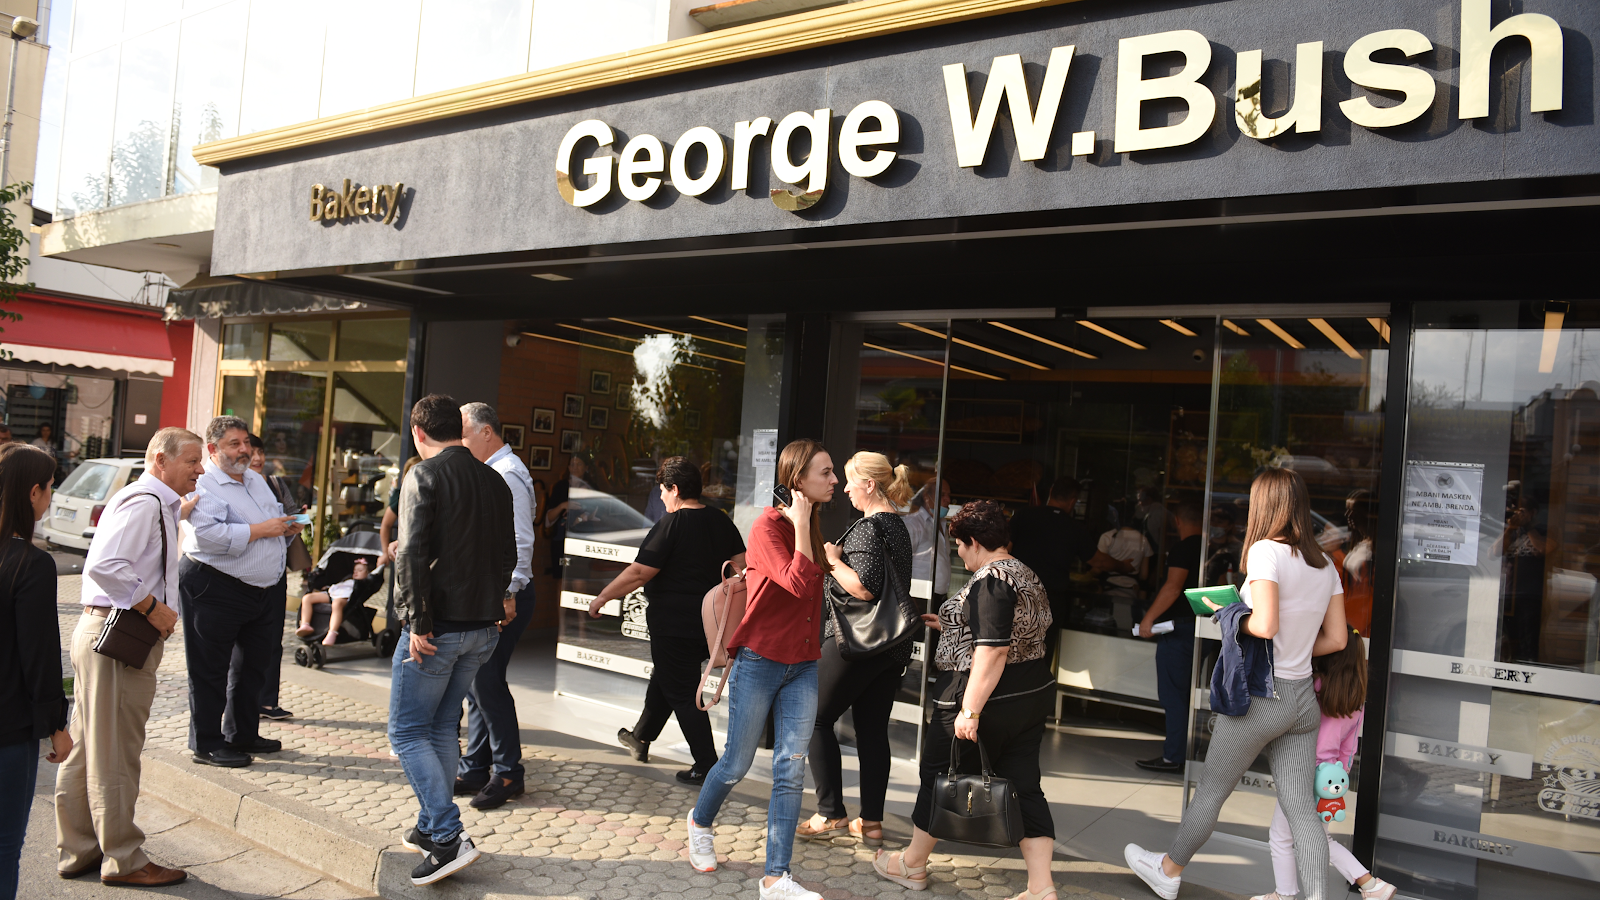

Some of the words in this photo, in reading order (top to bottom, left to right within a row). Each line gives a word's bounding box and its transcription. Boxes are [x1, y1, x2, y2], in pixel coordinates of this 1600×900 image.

[555, 100, 901, 211] George
[309, 178, 404, 225] Bakery
[585, 545, 620, 556] BAKERY
[576, 651, 611, 665] BAKERY
[1450, 662, 1537, 683] BAKERY
[703, 679, 720, 689] USH
[1417, 741, 1502, 765] BAKERY
[1433, 830, 1519, 857] BAKERY
